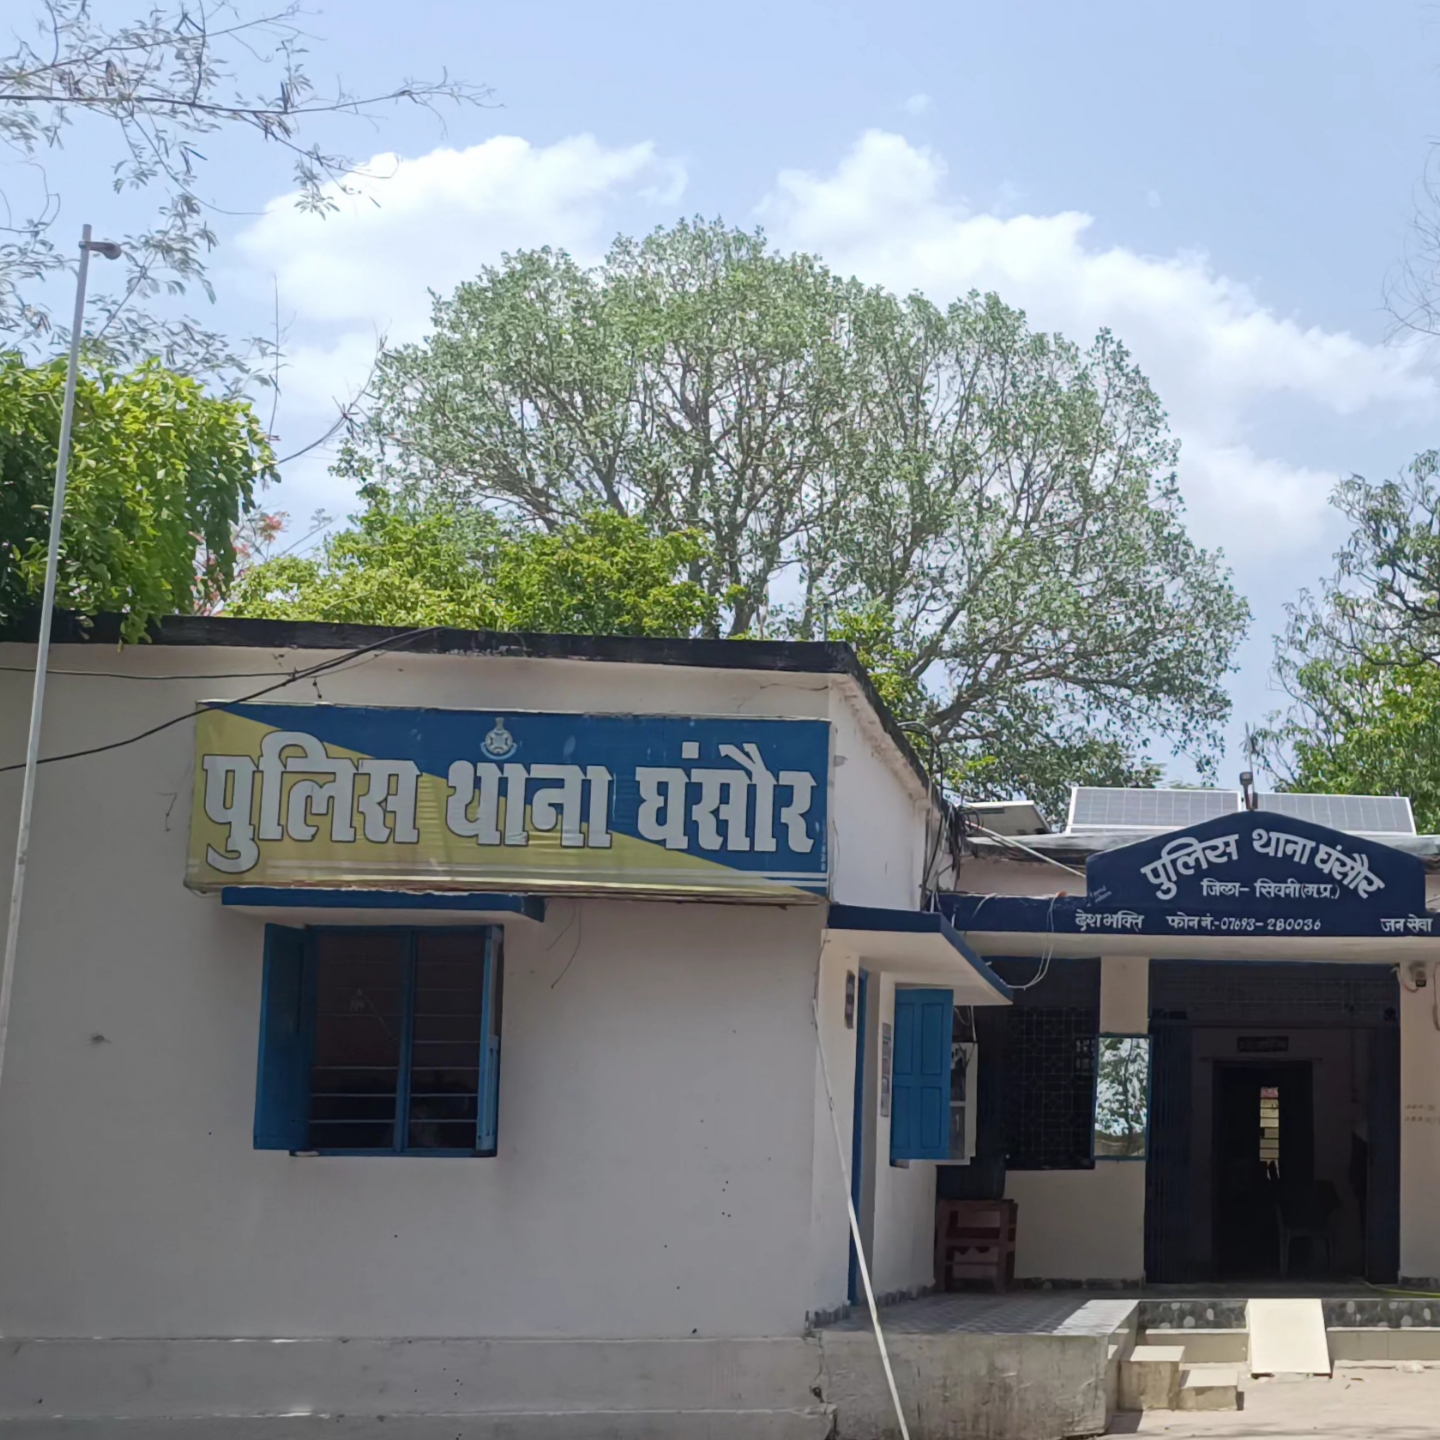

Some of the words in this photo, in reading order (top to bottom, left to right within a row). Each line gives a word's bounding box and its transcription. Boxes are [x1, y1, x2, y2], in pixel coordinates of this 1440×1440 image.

[202, 729, 421, 874] पुलिस
[446, 760, 613, 849] थाना
[635, 740, 817, 854] घंसौर
[1140, 834, 1239, 900] पुलिस
[1252, 829, 1316, 865] थाना
[1314, 844, 1386, 899] घंसौर
[1165, 911, 1199, 929] फोन
[1380, 918, 1405, 932] जन
[1406, 913, 1433, 932] सेवा
